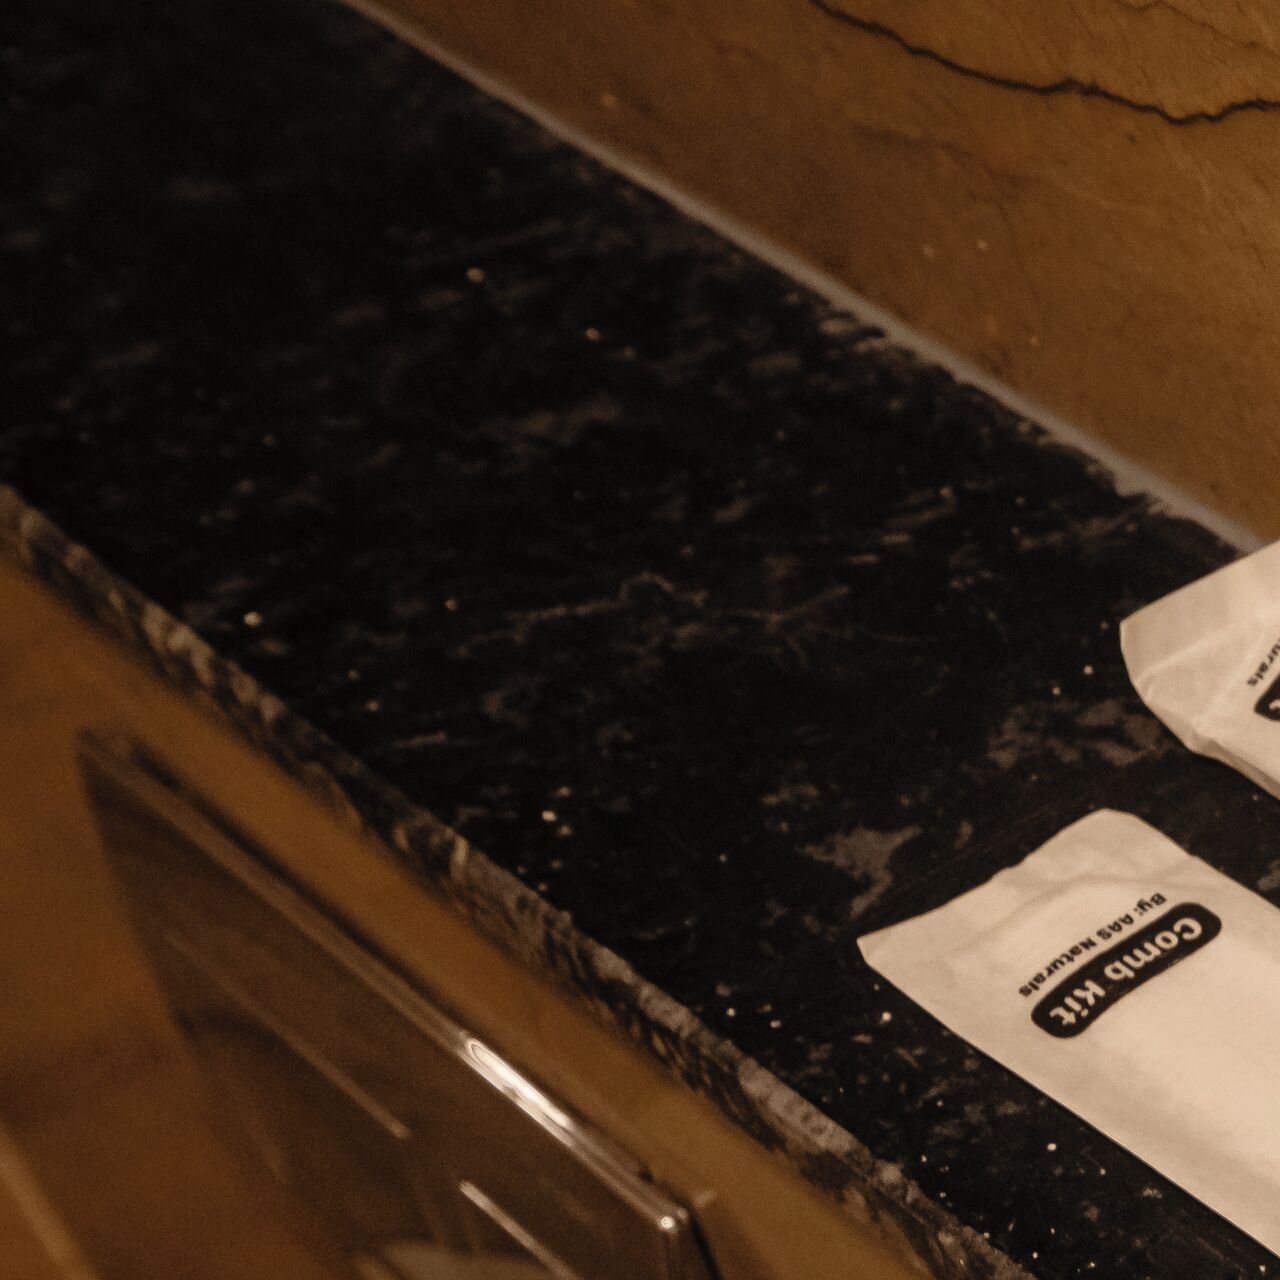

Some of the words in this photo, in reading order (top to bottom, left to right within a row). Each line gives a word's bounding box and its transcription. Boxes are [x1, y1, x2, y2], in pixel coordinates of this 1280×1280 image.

[1096, 913, 1134, 940] AAS
[1103, 917, 1203, 981] Comb
[1018, 937, 1097, 997] Naturals
[1049, 979, 1106, 1026] Kit
